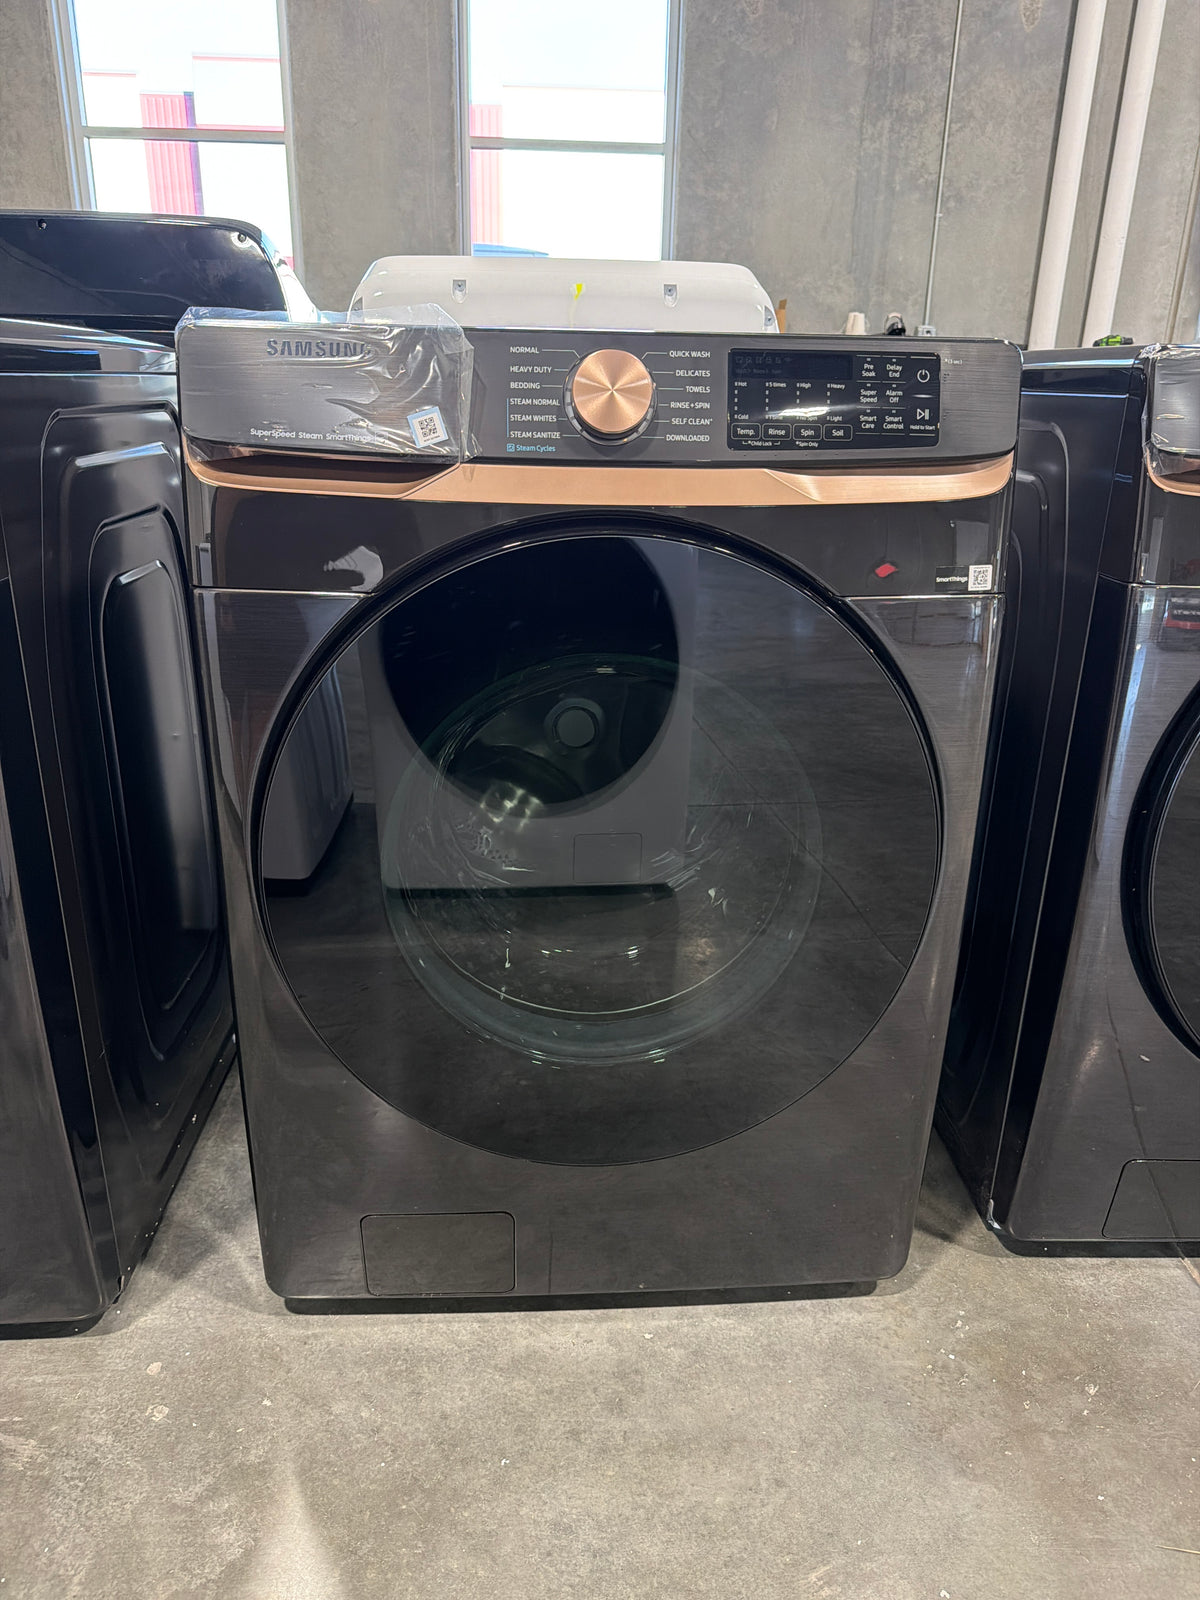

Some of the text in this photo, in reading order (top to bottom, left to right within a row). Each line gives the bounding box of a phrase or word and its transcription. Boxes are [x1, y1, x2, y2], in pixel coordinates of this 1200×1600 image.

[510, 346, 539, 354] NORMAL
[669, 350, 690, 358] QUICK
[510, 365, 552, 374] HEAVY DUTY
[886, 364, 903, 372] Delay
[675, 369, 711, 378] DELICATES
[861, 370, 876, 378] Soak
[510, 381, 541, 390] BEDDING
[738, 380, 748, 388] Hot
[830, 383, 846, 391] Heavy
[685, 385, 711, 393] TOWELS
[860, 389, 877, 397] Super
[885, 389, 903, 397] Alarm
[510, 397, 561, 407] STEAM NORMAL
[860, 396, 878, 404] Speed
[889, 396, 900, 404] Off
[510, 414, 557, 423] STEAM WHITES
[671, 417, 687, 426] SELF
[830, 415, 843, 423] Light
[859, 414, 877, 422] Smart
[885, 415, 903, 423] Smart
[883, 422, 904, 430] Control
[250, 427, 296, 439] SuperSpeed
[298, 430, 324, 440] Steam
[510, 430, 561, 439] STEAM SANITIZE
[737, 427, 755, 437] Temp.
[768, 428, 786, 436] Rinse
[800, 428, 815, 437] Spin
[831, 429, 844, 437] Soil
[666, 434, 710, 442] DOWNLOADED
[516, 444, 556, 453] Steam Cycles
[935, 575, 968, 584] SmartThings
